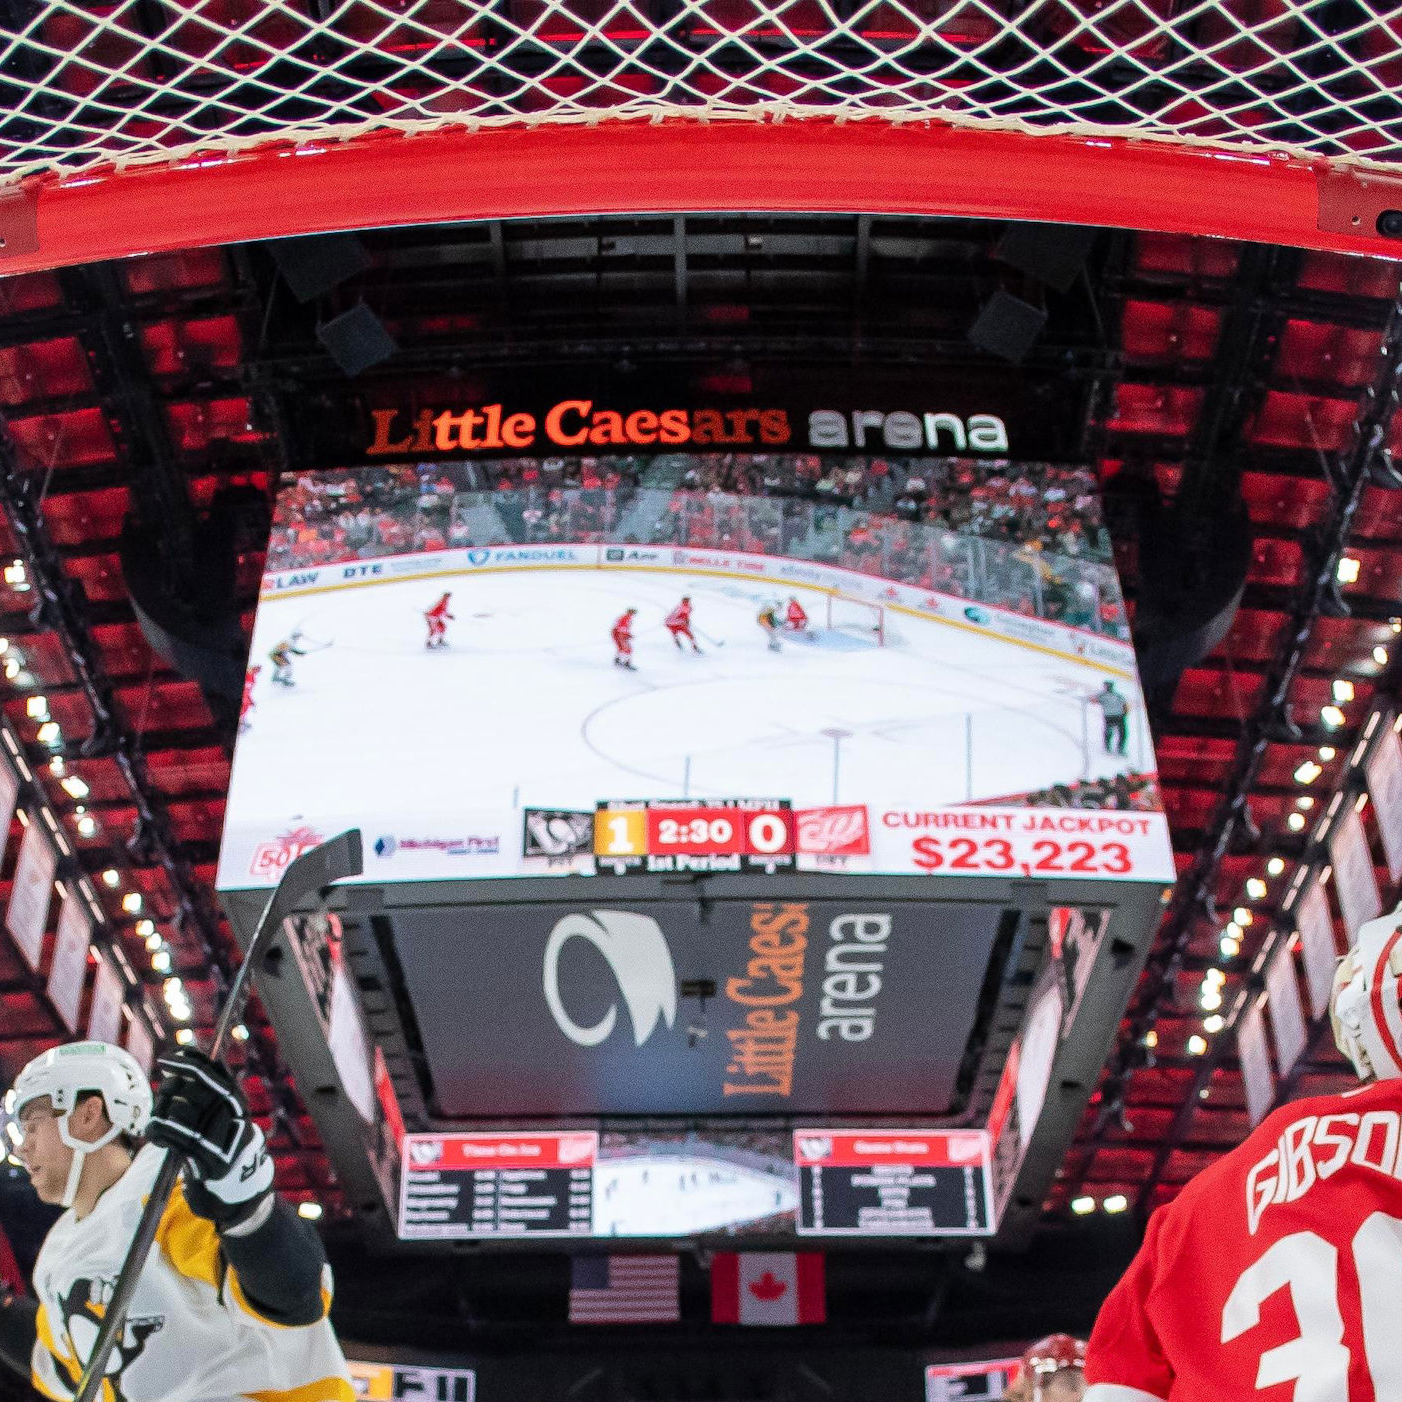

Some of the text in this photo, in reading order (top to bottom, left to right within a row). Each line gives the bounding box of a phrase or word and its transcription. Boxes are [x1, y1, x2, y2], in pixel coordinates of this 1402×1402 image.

[365, 400, 1009, 456] Little Caesars arena
[342, 563, 384, 580] DTE
[607, 816, 633, 853] 1
[657, 818, 734, 844] 2:30
[749, 813, 787, 854] 0
[881, 811, 1151, 836] CURRENT JACKPOT
[678, 855, 741, 872] Period
[911, 835, 1133, 880] $23,223
[815, 912, 893, 1043] arena
[722, 1009, 801, 1098] Little
